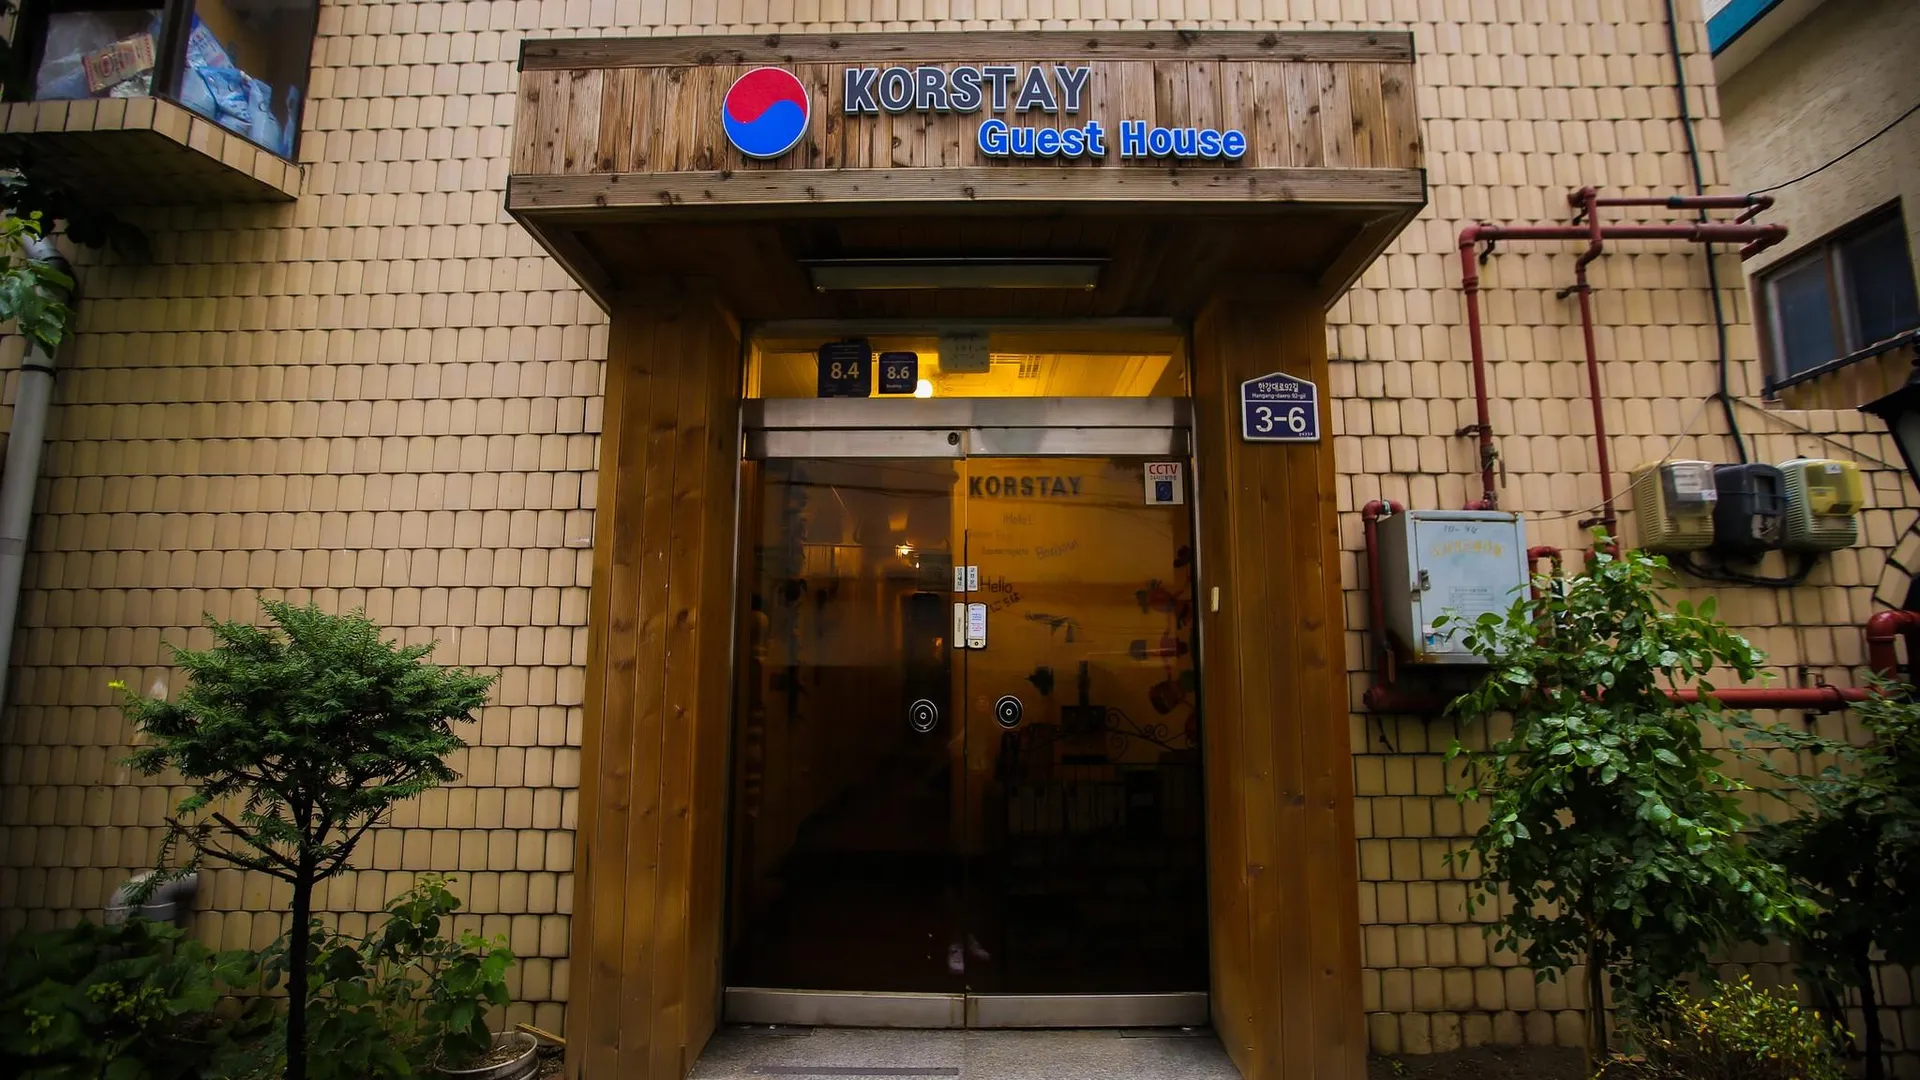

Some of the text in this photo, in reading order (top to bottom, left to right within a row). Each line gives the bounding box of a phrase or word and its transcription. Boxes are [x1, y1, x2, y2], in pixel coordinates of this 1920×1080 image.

[844, 65, 1091, 114] KORSTAY
[977, 119, 1248, 159] Guest House
[830, 362, 860, 380] 8.4
[886, 366, 910, 380] 8.6
[1258, 382, 1299, 393] 한강대로92길
[1255, 406, 1307, 433] 3-6
[1148, 464, 1178, 475] CCTV
[968, 475, 1081, 497] KORSTAY
[980, 575, 1013, 595] Hello
